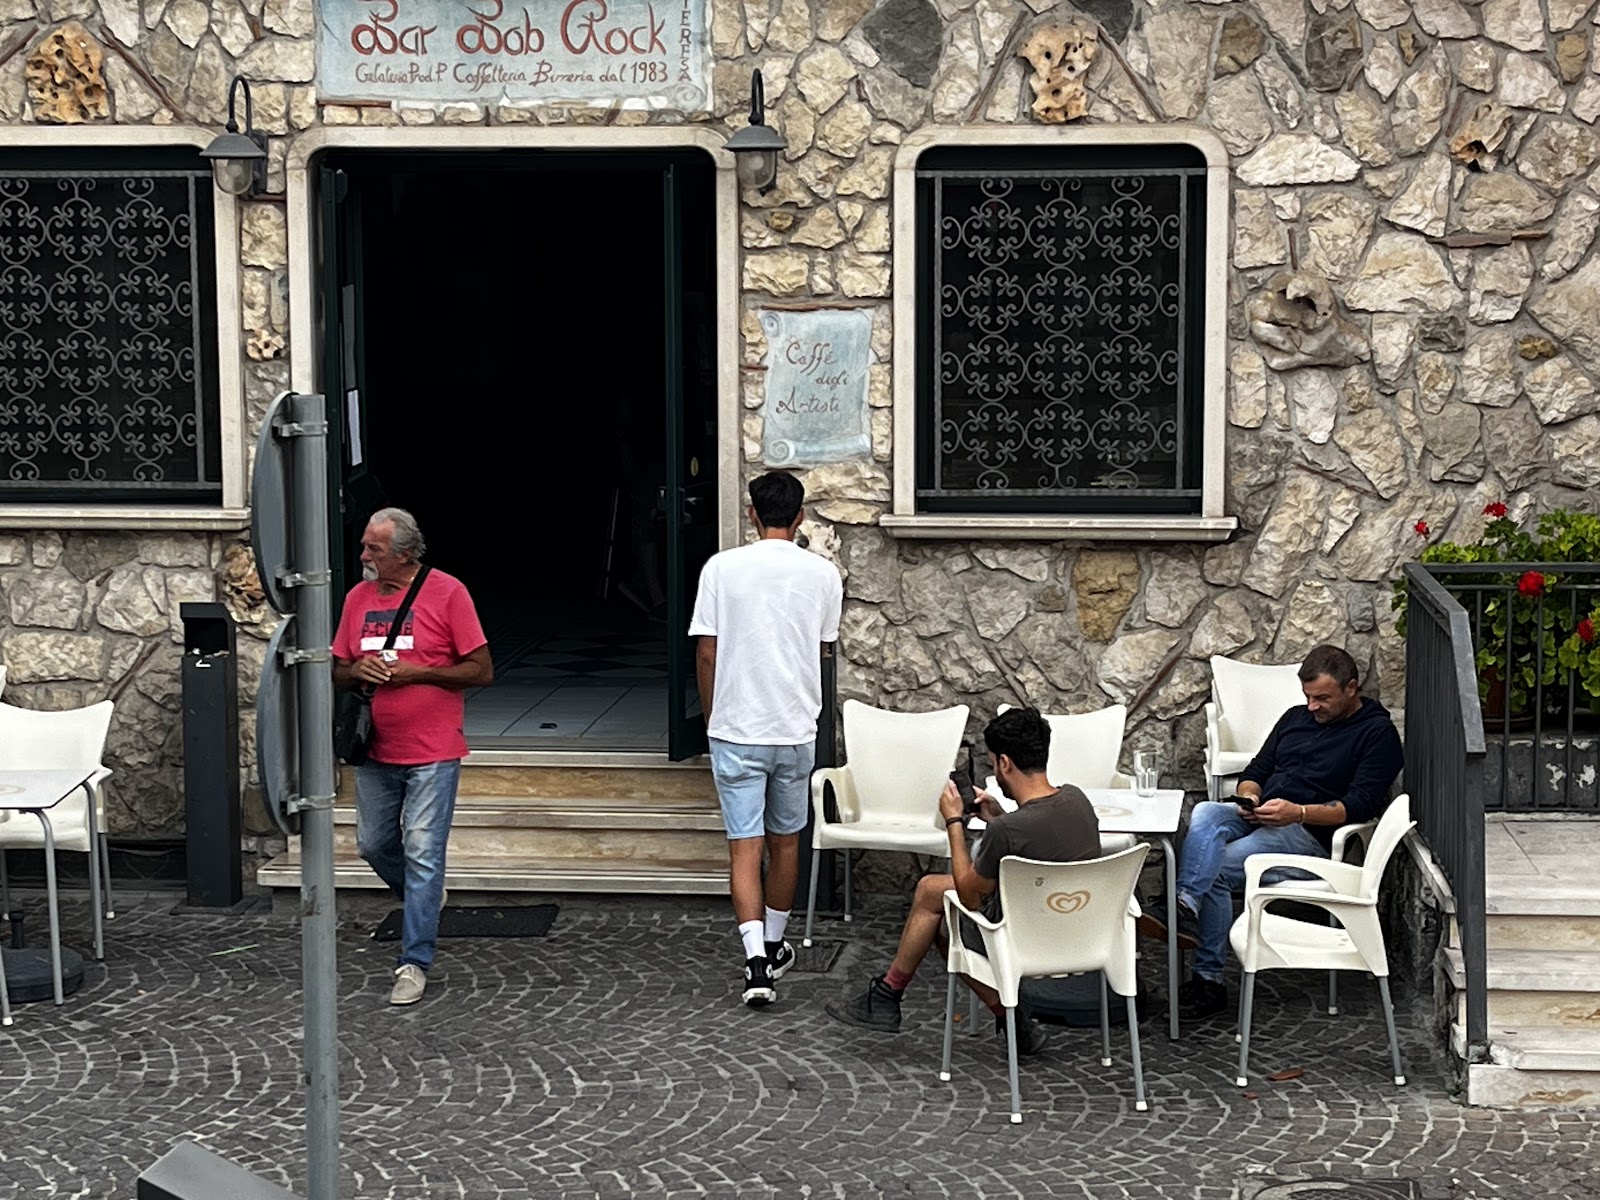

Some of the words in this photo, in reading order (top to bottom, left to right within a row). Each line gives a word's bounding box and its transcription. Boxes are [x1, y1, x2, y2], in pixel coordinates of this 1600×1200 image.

[351, 0, 437, 56] Bar
[456, 0, 544, 55] Bob
[560, 0, 667, 55] Rock
[453, 62, 527, 92] Caffetteria
[528, 59, 595, 87] Birreria
[599, 64, 626, 82] dal
[630, 61, 668, 84] 1983
[775, 386, 840, 413] Artisti
